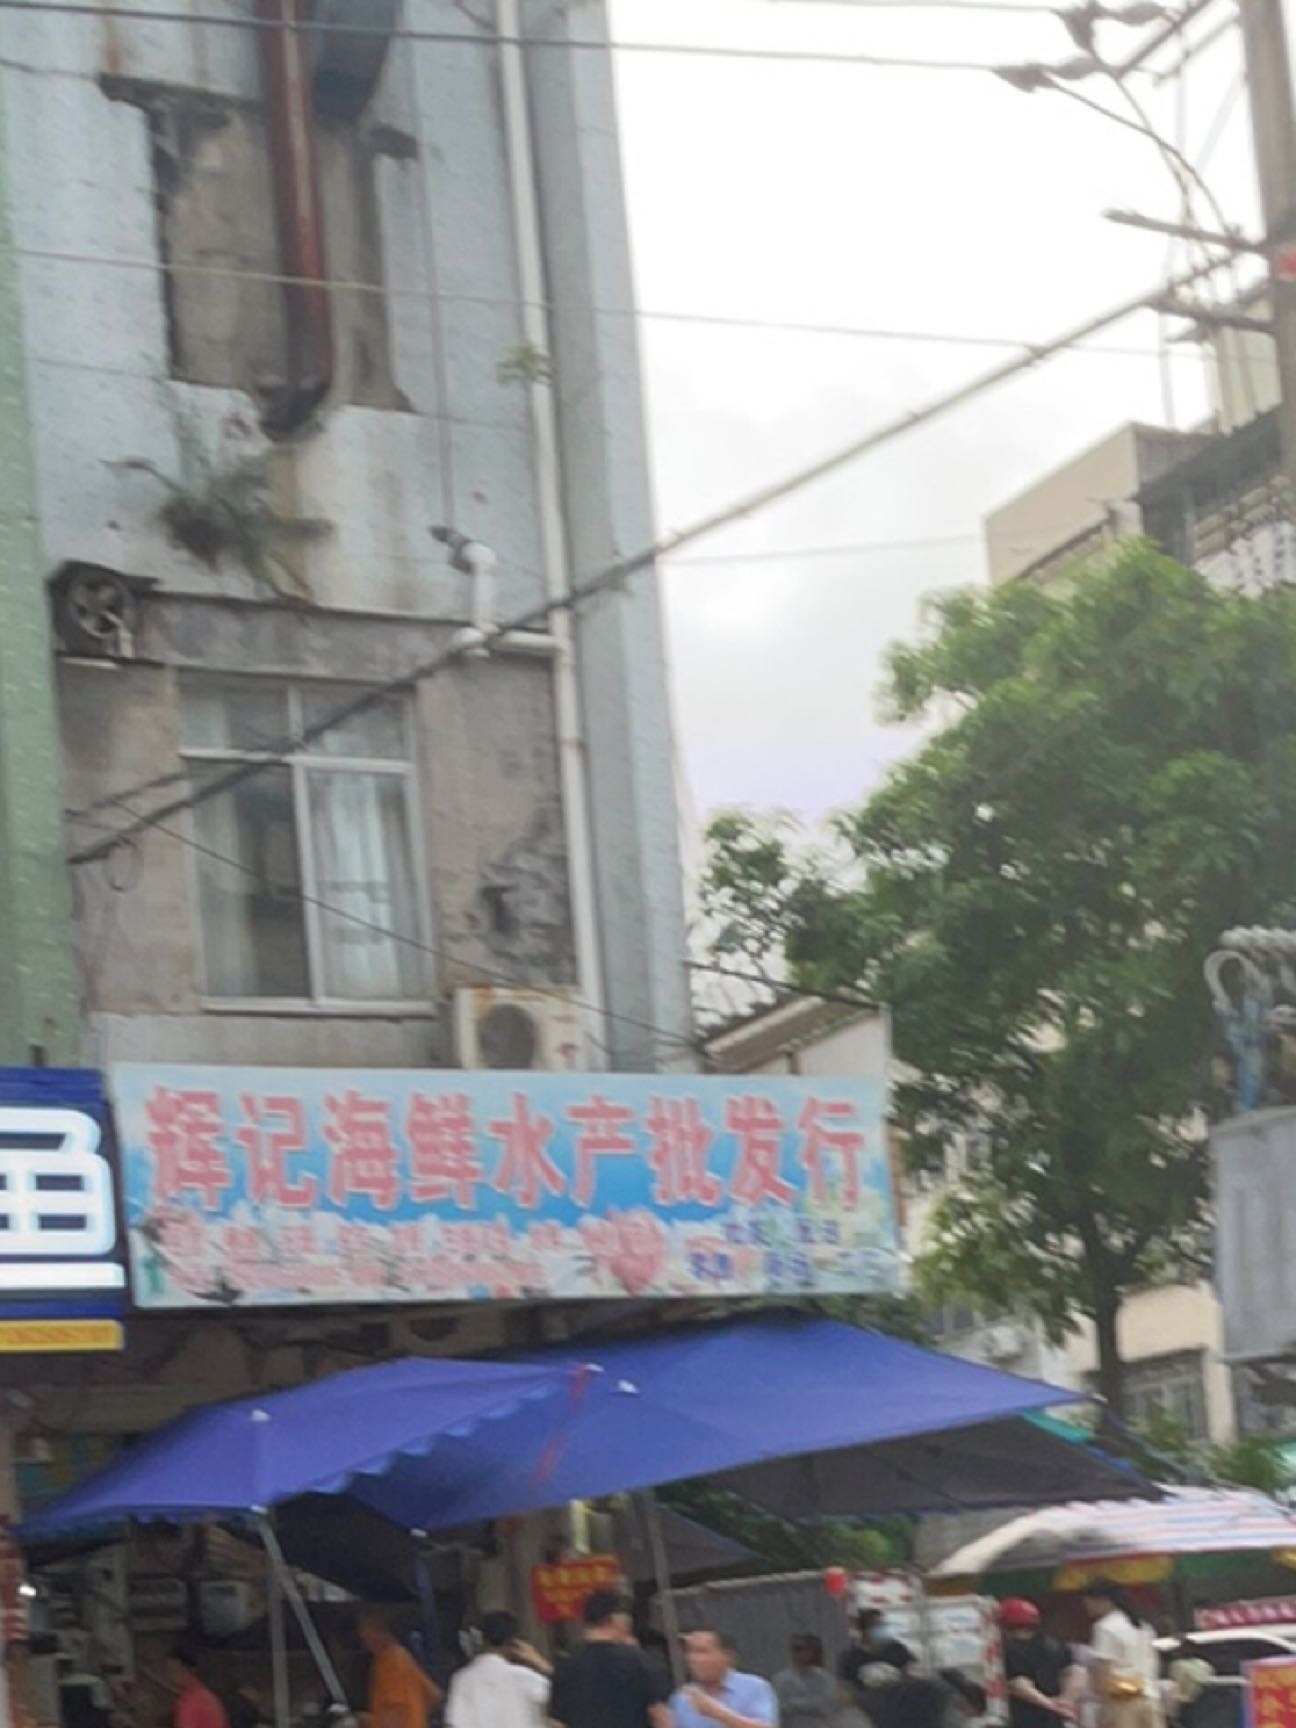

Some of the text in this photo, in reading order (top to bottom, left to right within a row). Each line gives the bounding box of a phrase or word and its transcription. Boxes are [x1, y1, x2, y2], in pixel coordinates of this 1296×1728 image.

[144, 1087, 865, 1211] 辉记海鲜水产批发行
